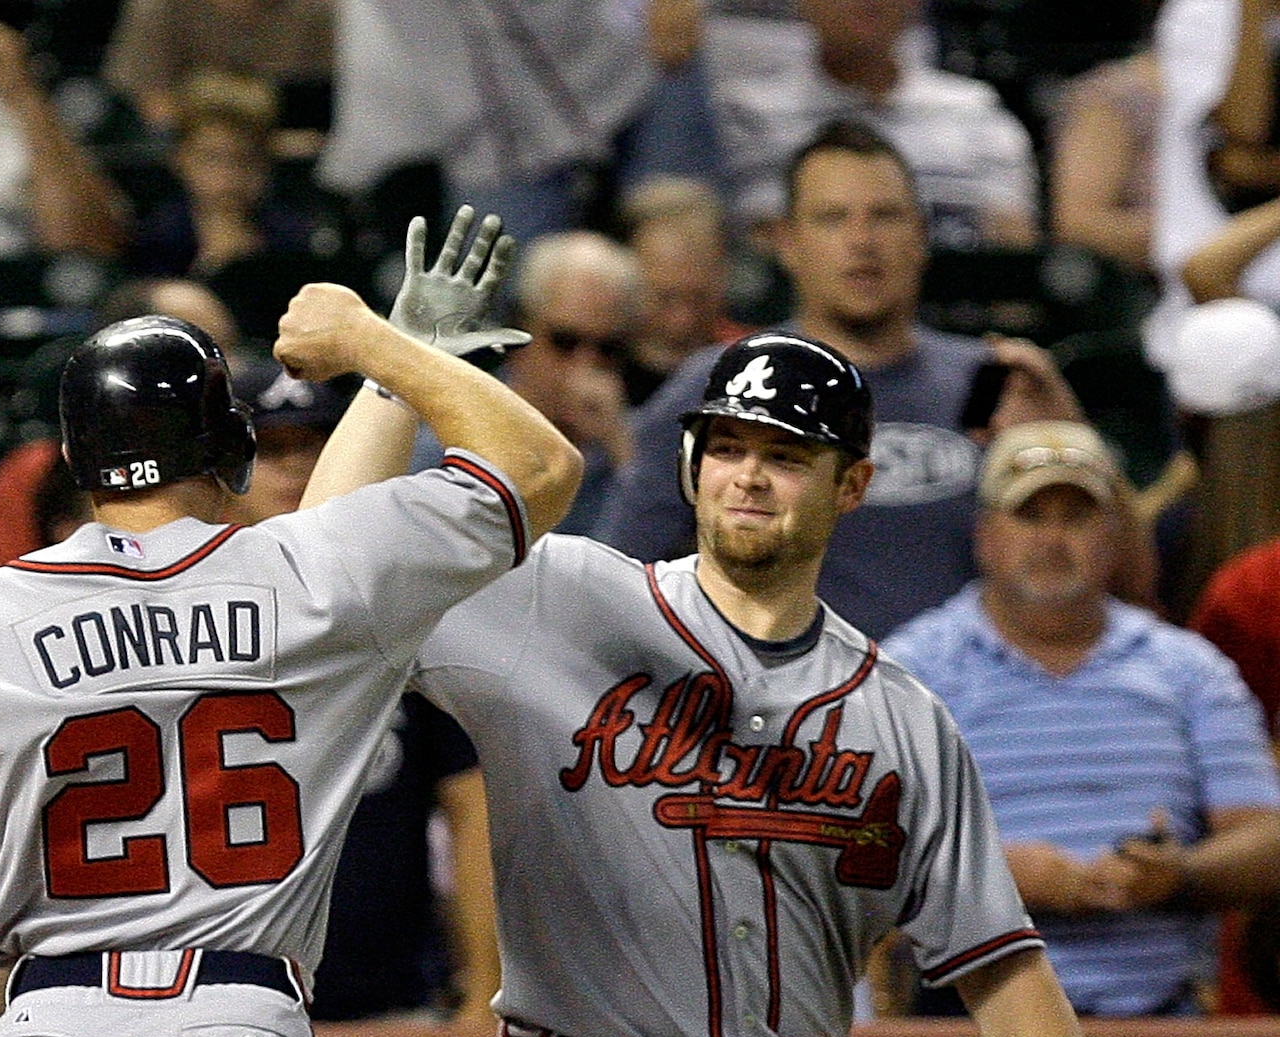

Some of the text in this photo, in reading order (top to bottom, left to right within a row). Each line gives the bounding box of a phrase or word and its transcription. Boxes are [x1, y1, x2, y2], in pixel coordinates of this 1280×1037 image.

[129, 459, 160, 487] 26
[32, 600, 261, 690] CONRAD
[41, 688, 306, 900] 26
[558, 671, 876, 807] Atlanta
